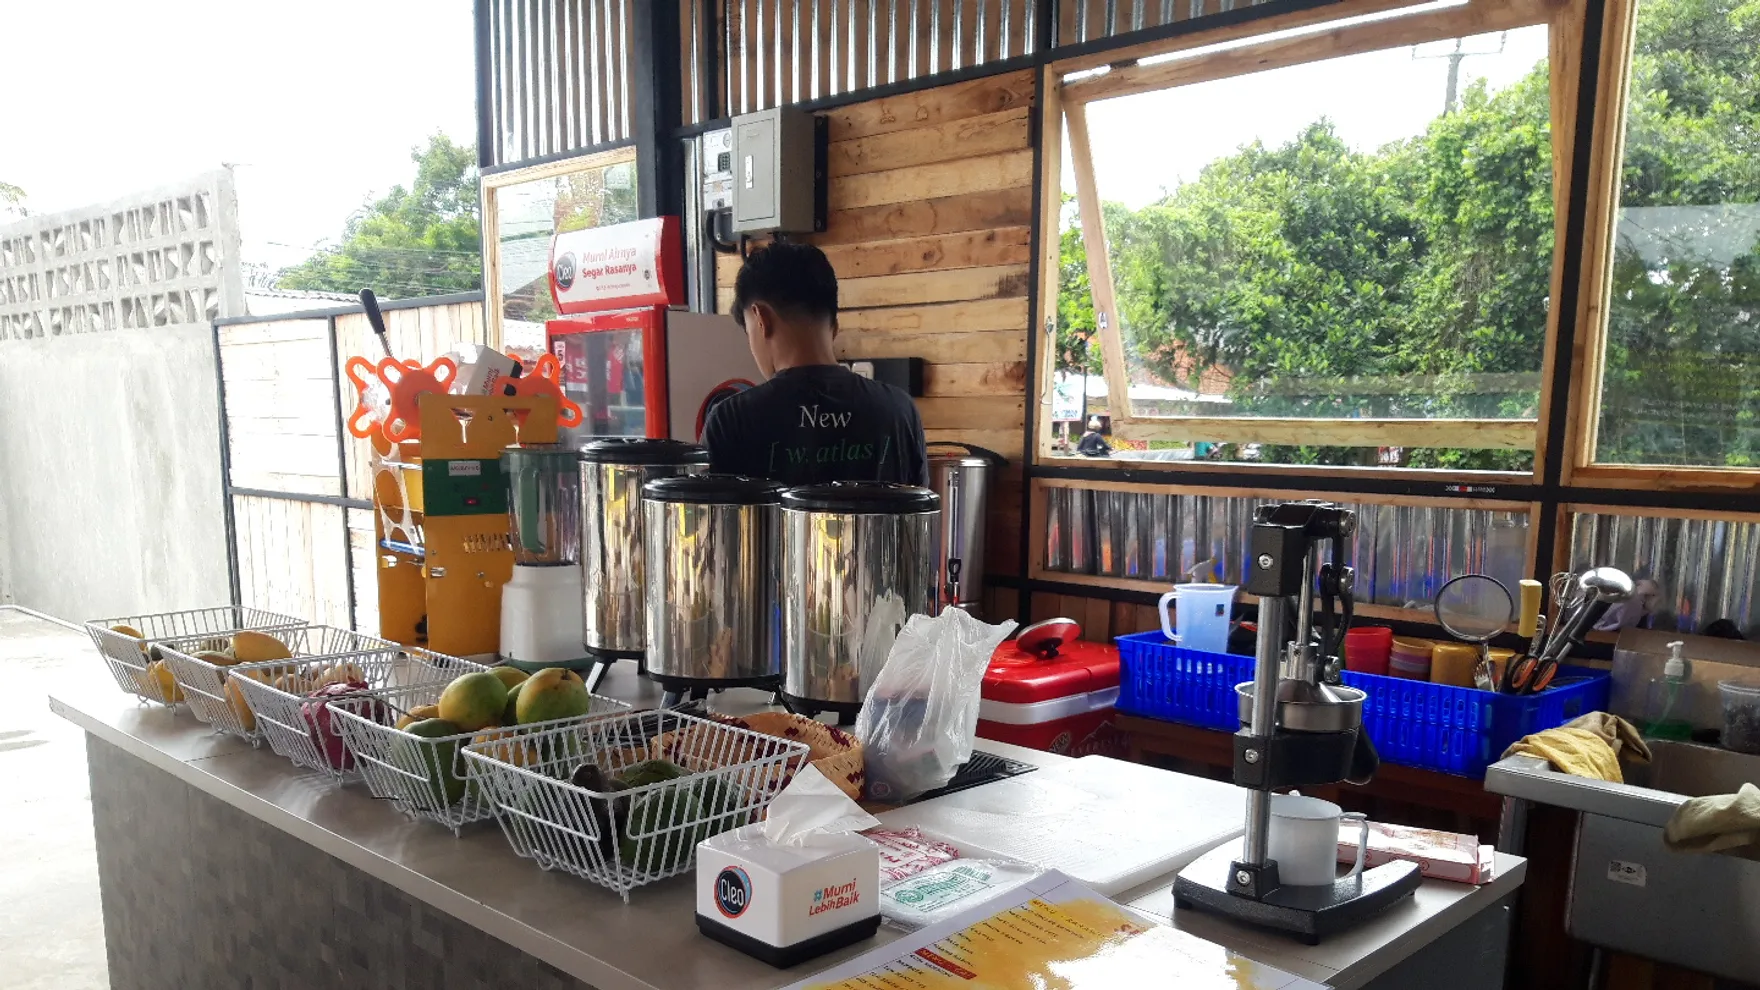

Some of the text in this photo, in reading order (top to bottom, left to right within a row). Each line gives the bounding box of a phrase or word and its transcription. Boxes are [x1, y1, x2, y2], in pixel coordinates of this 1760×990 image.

[582, 263, 637, 279] Segar Rasanya
[799, 405, 852, 429] New
[816, 438, 873, 464] atlas
[720, 878, 745, 907] Cleo
